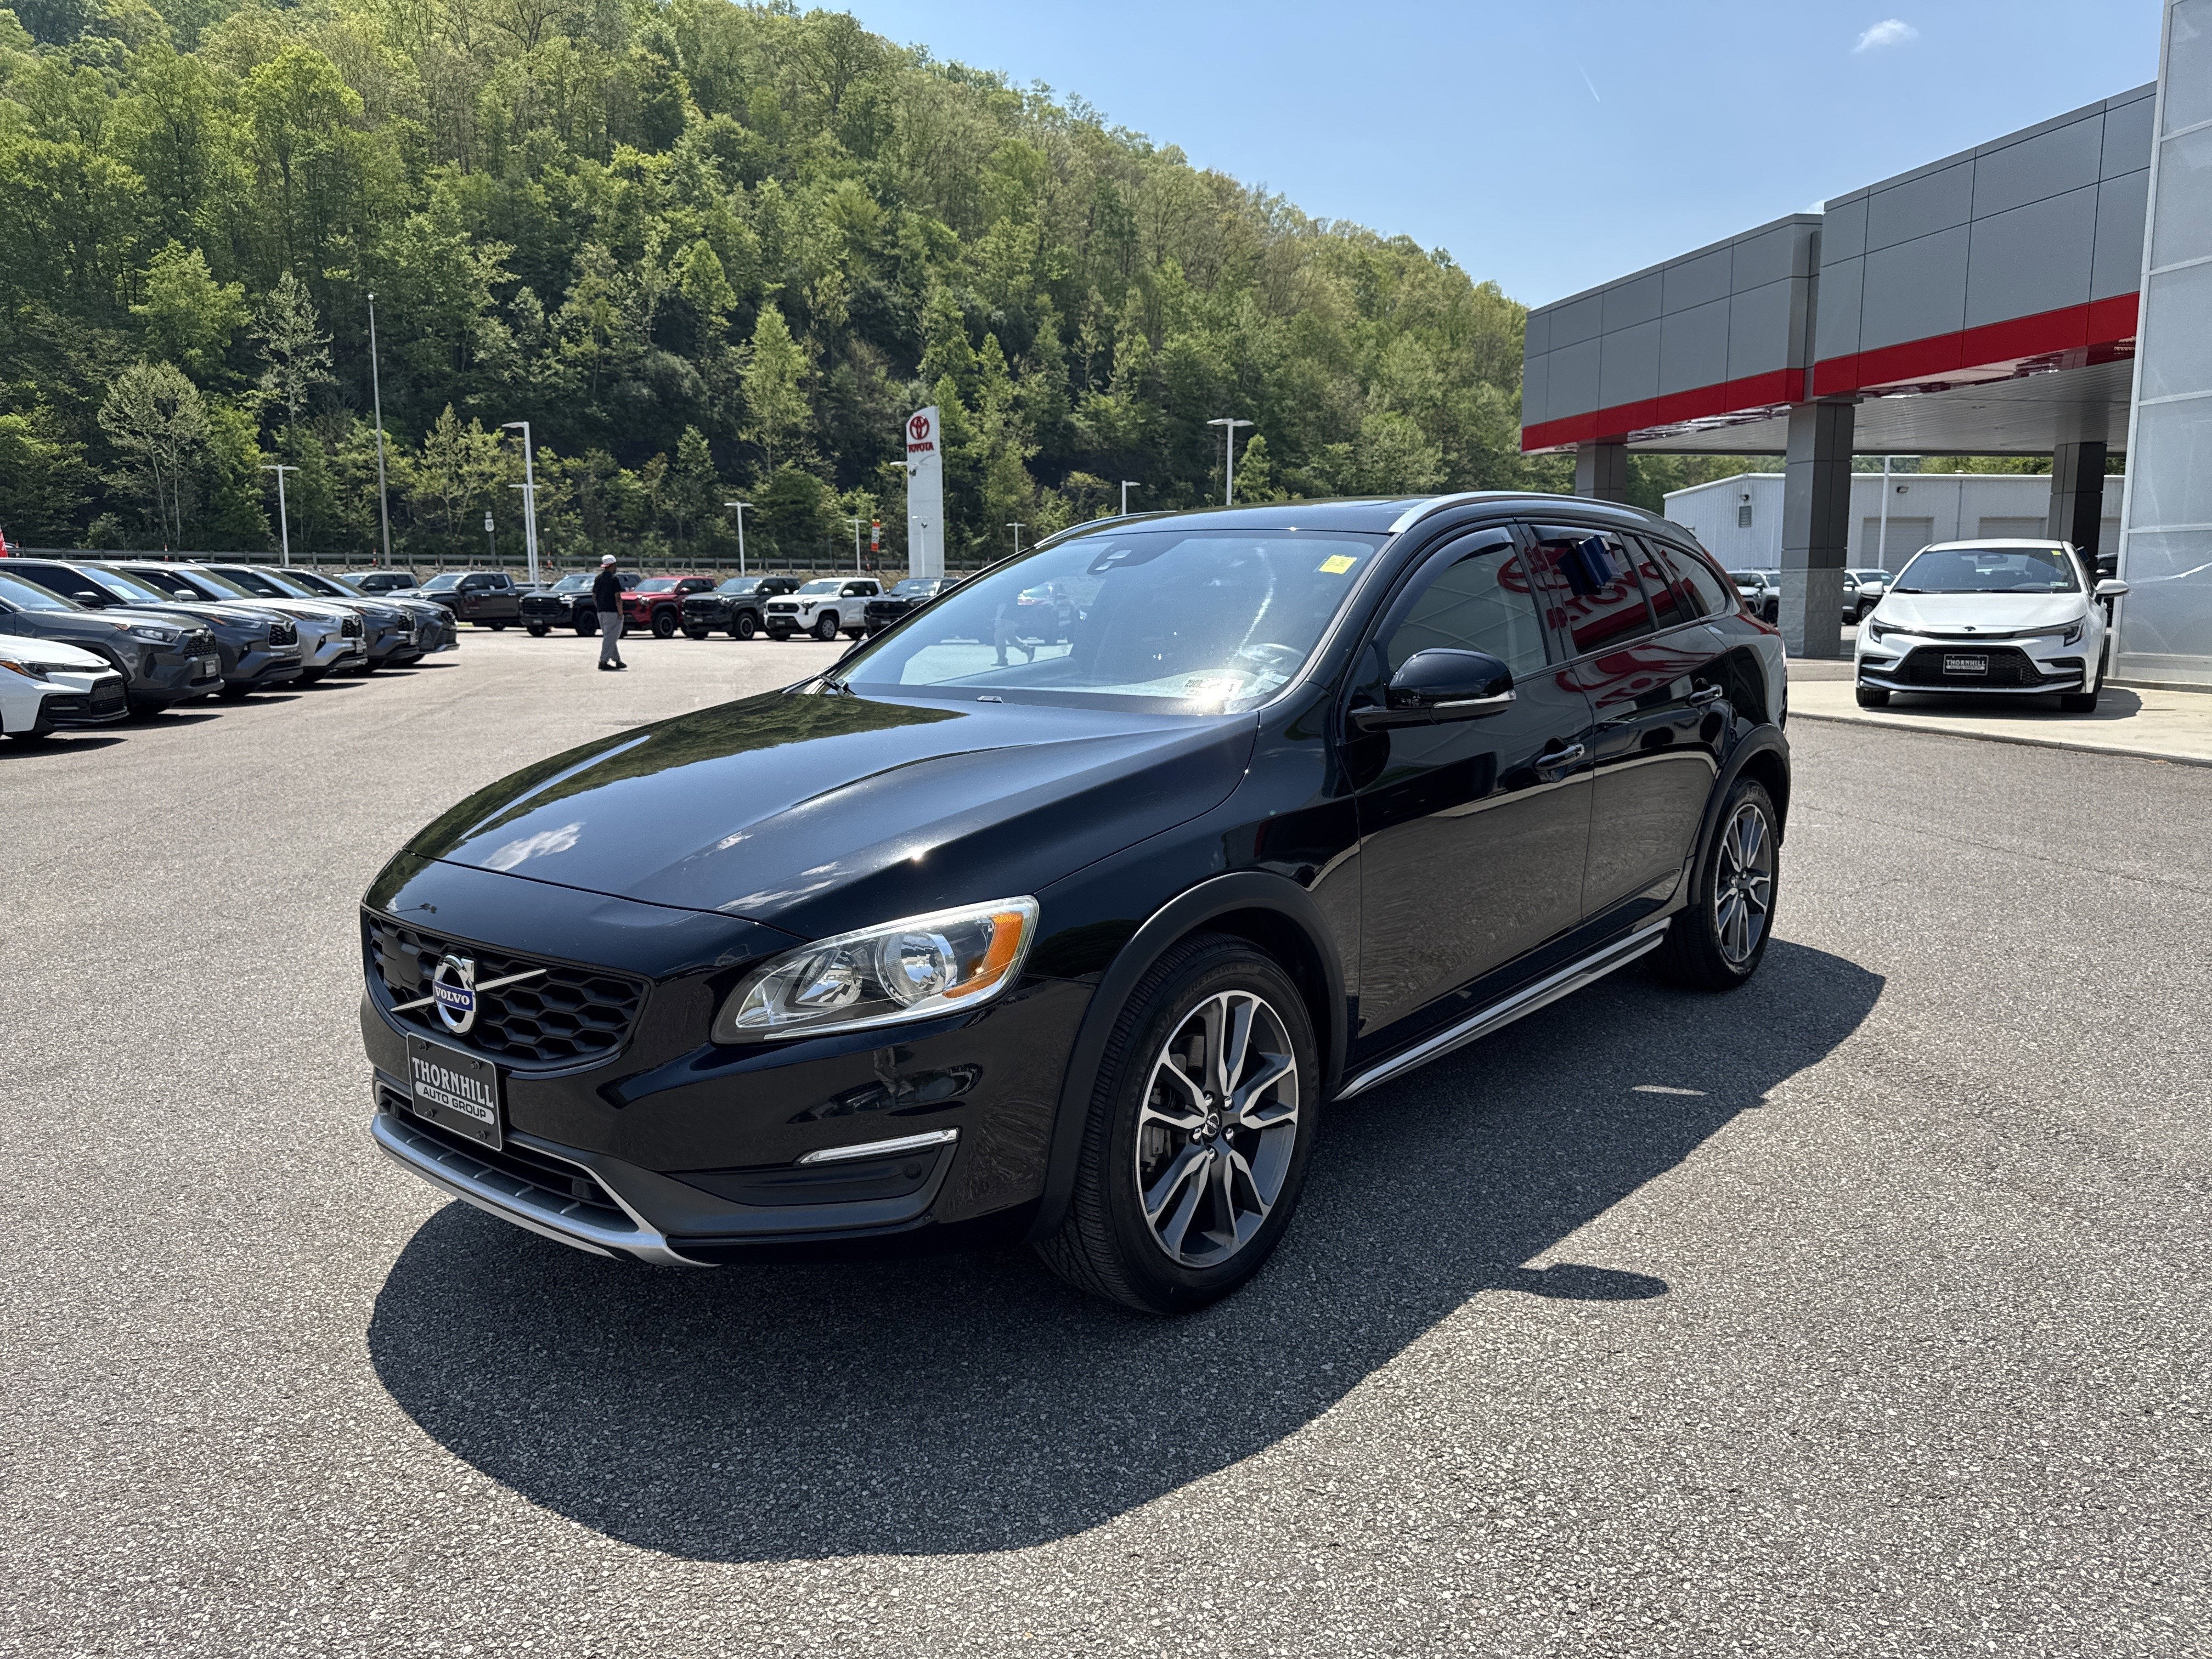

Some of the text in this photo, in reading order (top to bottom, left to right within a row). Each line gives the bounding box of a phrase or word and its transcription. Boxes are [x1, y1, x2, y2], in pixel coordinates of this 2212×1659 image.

[907, 442, 934, 453] TOYOTA
[434, 985, 470, 1005] VOLVO
[1180, 963, 1238, 1002] FIREHAWK
[412, 1057, 494, 1108] THORNHILL
[423, 1086, 486, 1118] AUTO GROUP
